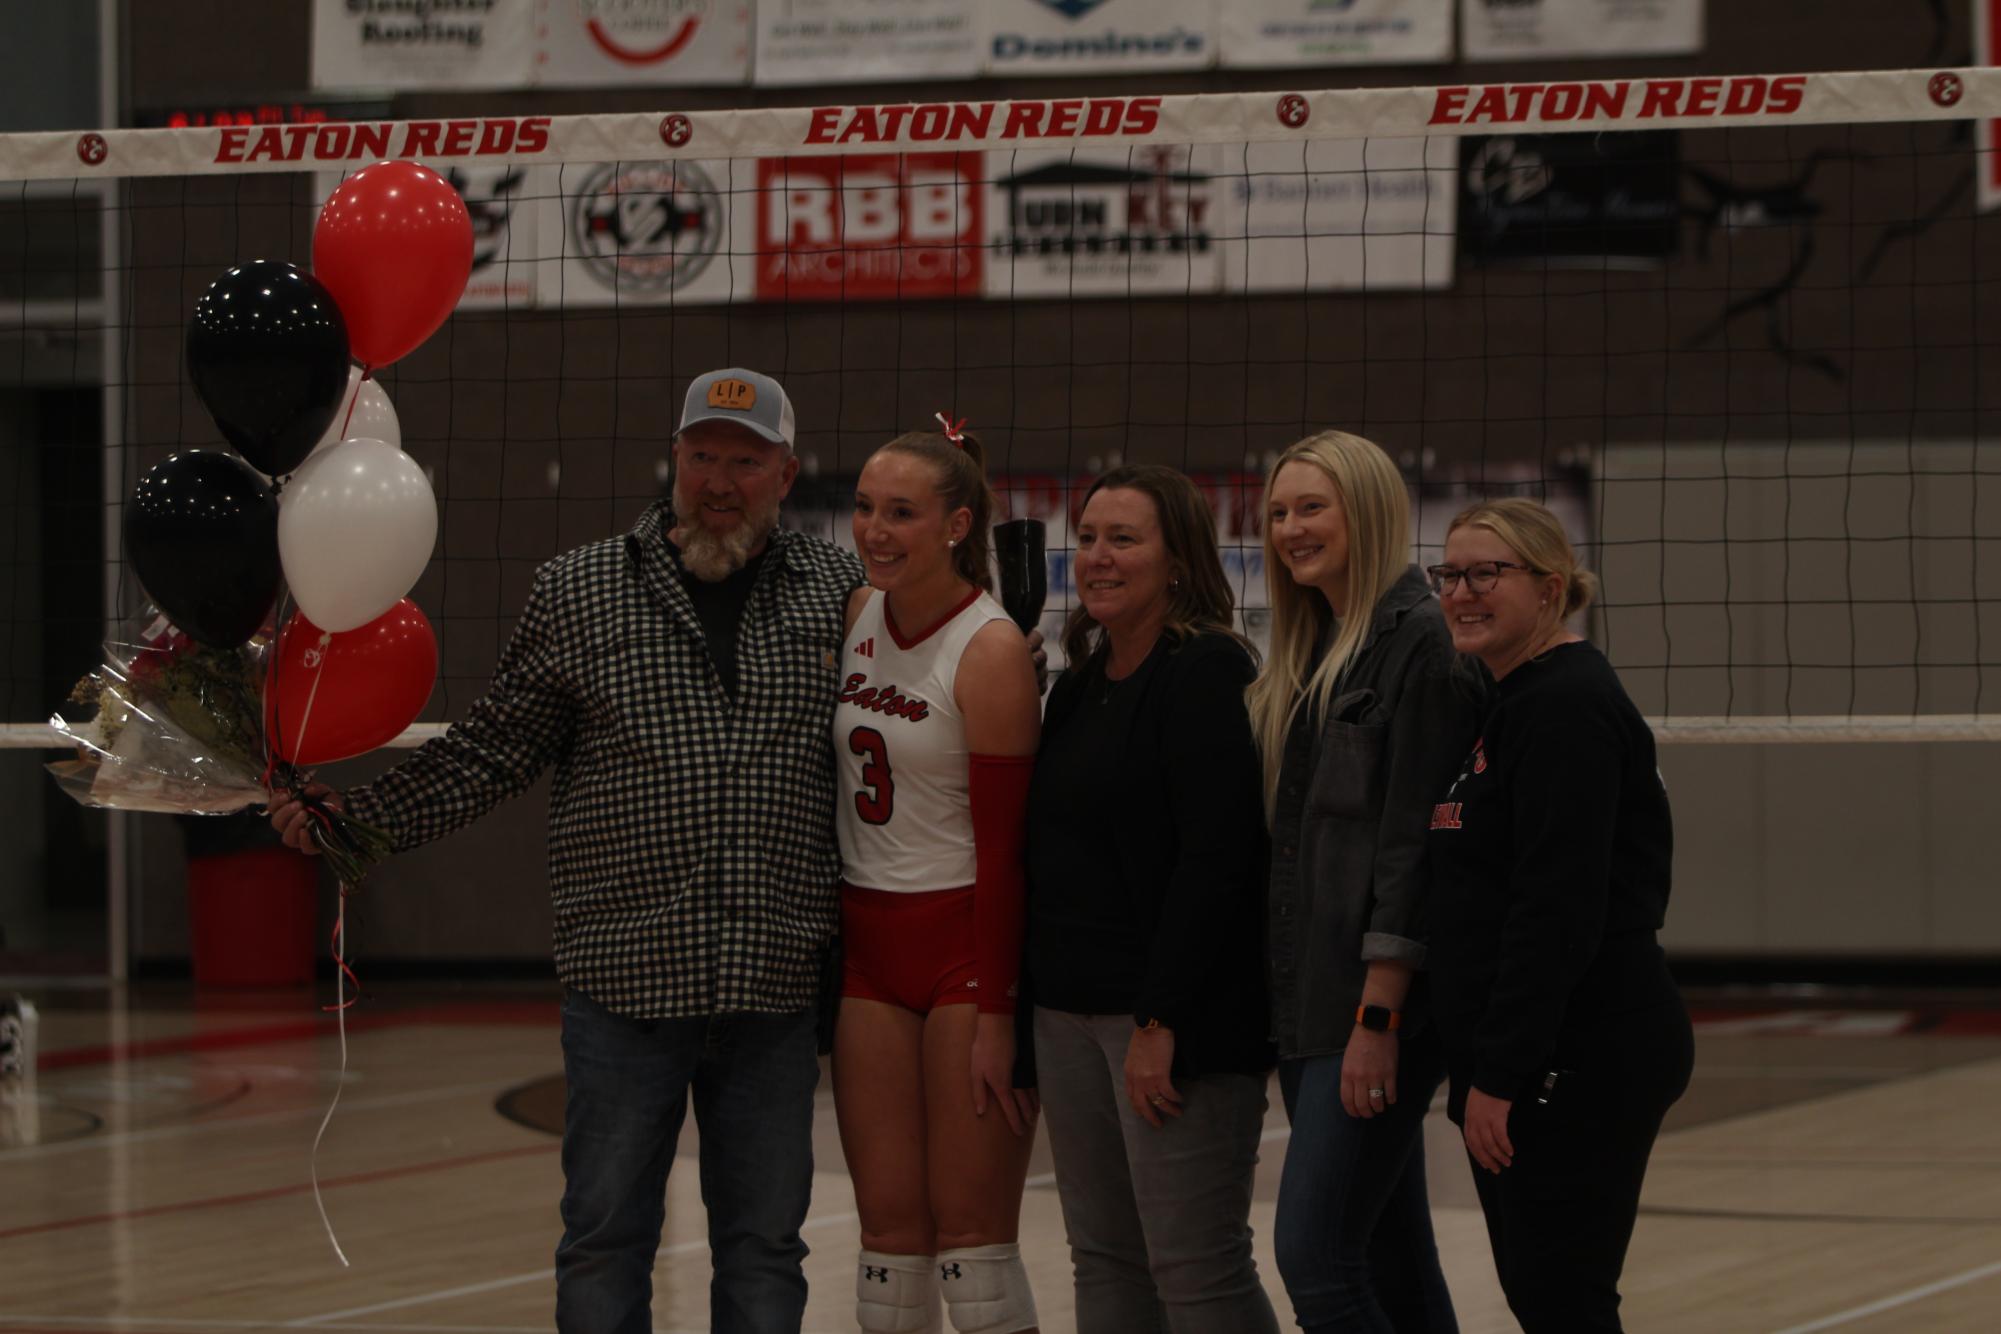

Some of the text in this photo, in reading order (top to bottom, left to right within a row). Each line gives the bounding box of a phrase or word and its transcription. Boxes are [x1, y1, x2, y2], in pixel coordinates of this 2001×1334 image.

[993, 27, 1204, 58] Domino's
[803, 97, 1162, 145] EATON REDS
[1427, 76, 1807, 125] EATON REDS
[214, 117, 552, 163] EATON REDS
[767, 171, 974, 246] RBB
[839, 673, 929, 722] Eaton
[850, 726, 894, 825] 3
